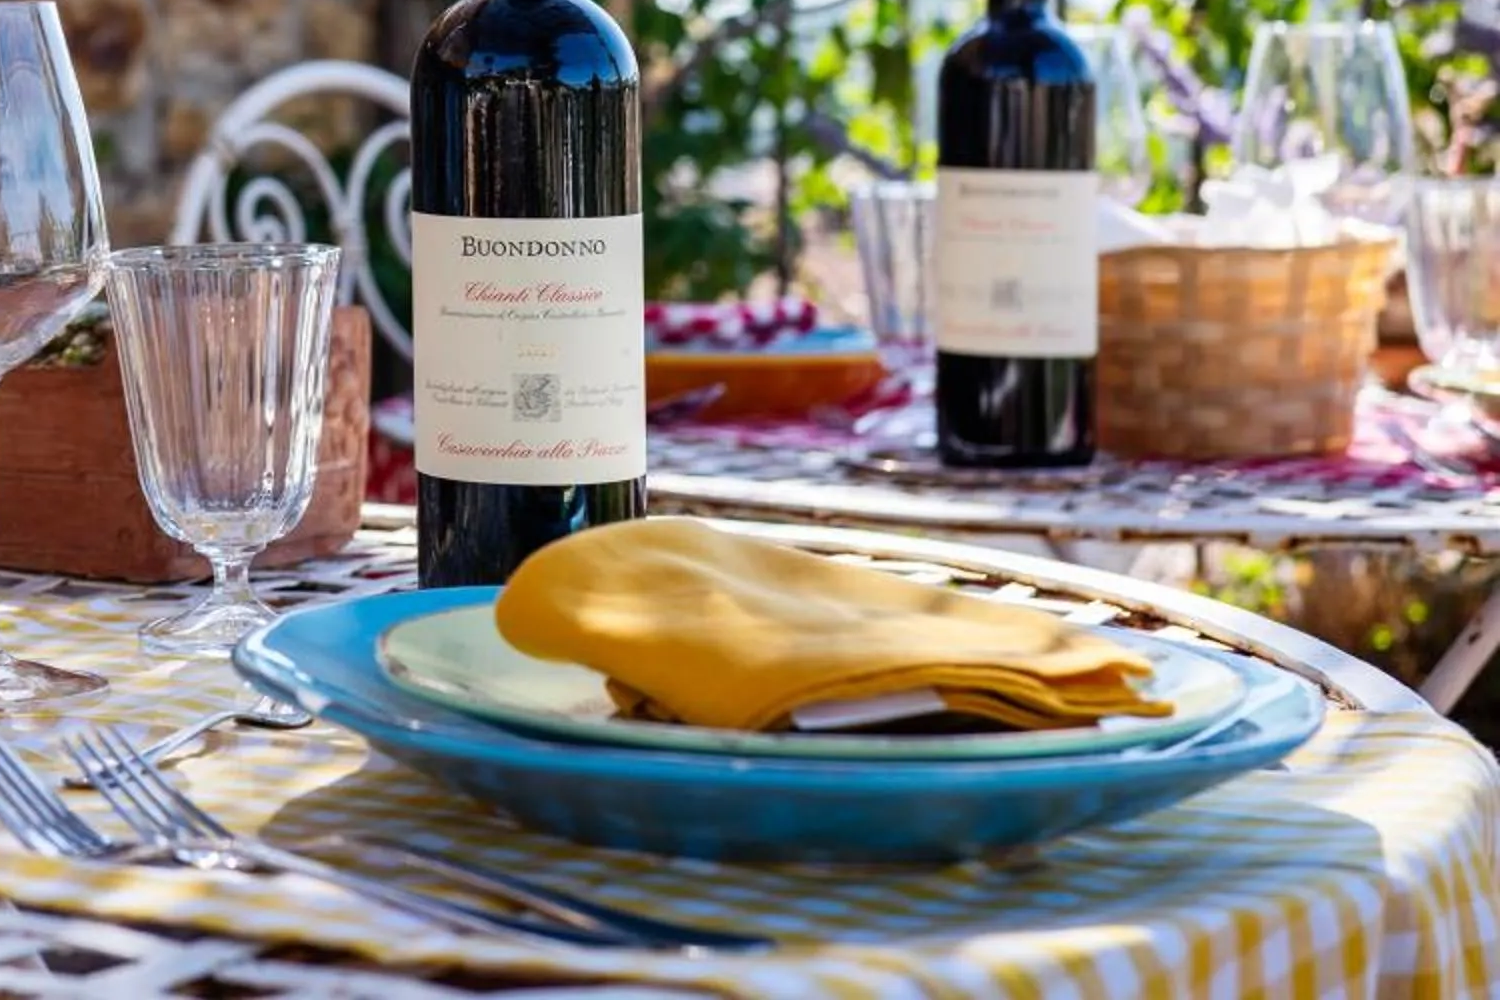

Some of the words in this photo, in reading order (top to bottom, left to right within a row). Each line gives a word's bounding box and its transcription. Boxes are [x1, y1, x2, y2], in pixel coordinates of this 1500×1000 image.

[460, 235, 607, 258] BUONDONNO
[464, 281, 529, 302] Chianti
[536, 281, 603, 302] Classico
